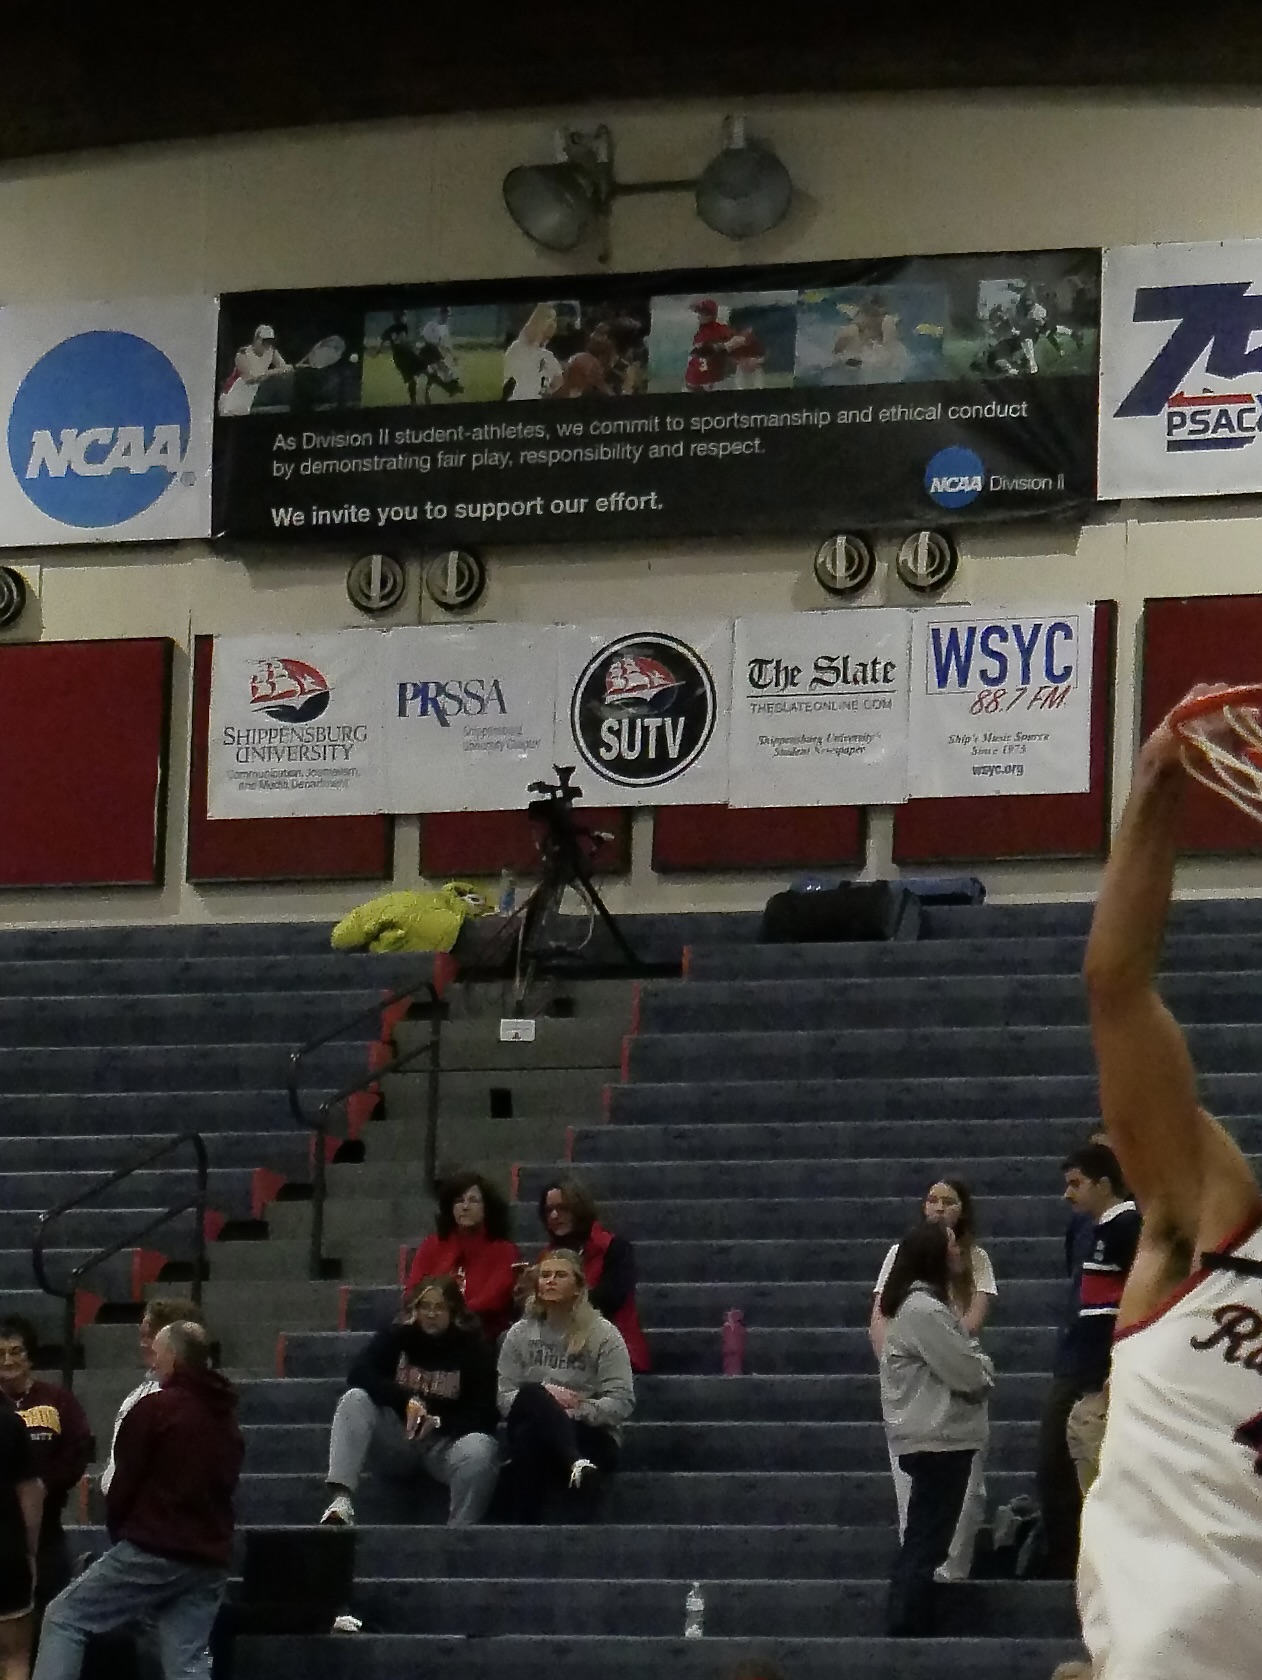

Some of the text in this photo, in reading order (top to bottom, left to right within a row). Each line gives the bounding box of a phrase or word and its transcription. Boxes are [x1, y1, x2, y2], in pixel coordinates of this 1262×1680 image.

[273, 433, 296, 451] As
[302, 430, 372, 450] Division
[395, 420, 550, 446] student-athletes,
[556, 420, 583, 437] we
[590, 412, 660, 434] commit
[667, 414, 684, 432] to
[690, 408, 830, 432] sportsmanship
[837, 406, 871, 425] and
[879, 402, 940, 422] ethical
[948, 400, 1028, 420] conduct
[1167, 405, 1257, 437] PSAC
[26, 425, 183, 480] NCAA
[273, 438, 765, 480] by demonstrating fair play, responsibility and respect.
[930, 475, 983, 494] NCAA
[990, 475, 1052, 492] Division
[271, 490, 663, 527] We invite you to support our effort.
[748, 654, 897, 693] The Slate
[931, 621, 1074, 690] WSYC
[396, 678, 508, 727] PRSSA
[969, 684, 1073, 716] 88.7 FM
[223, 725, 368, 746] SHIPPENSBURG
[235, 743, 355, 764] UNIVERSITY
[600, 716, 686, 761] SUTV
